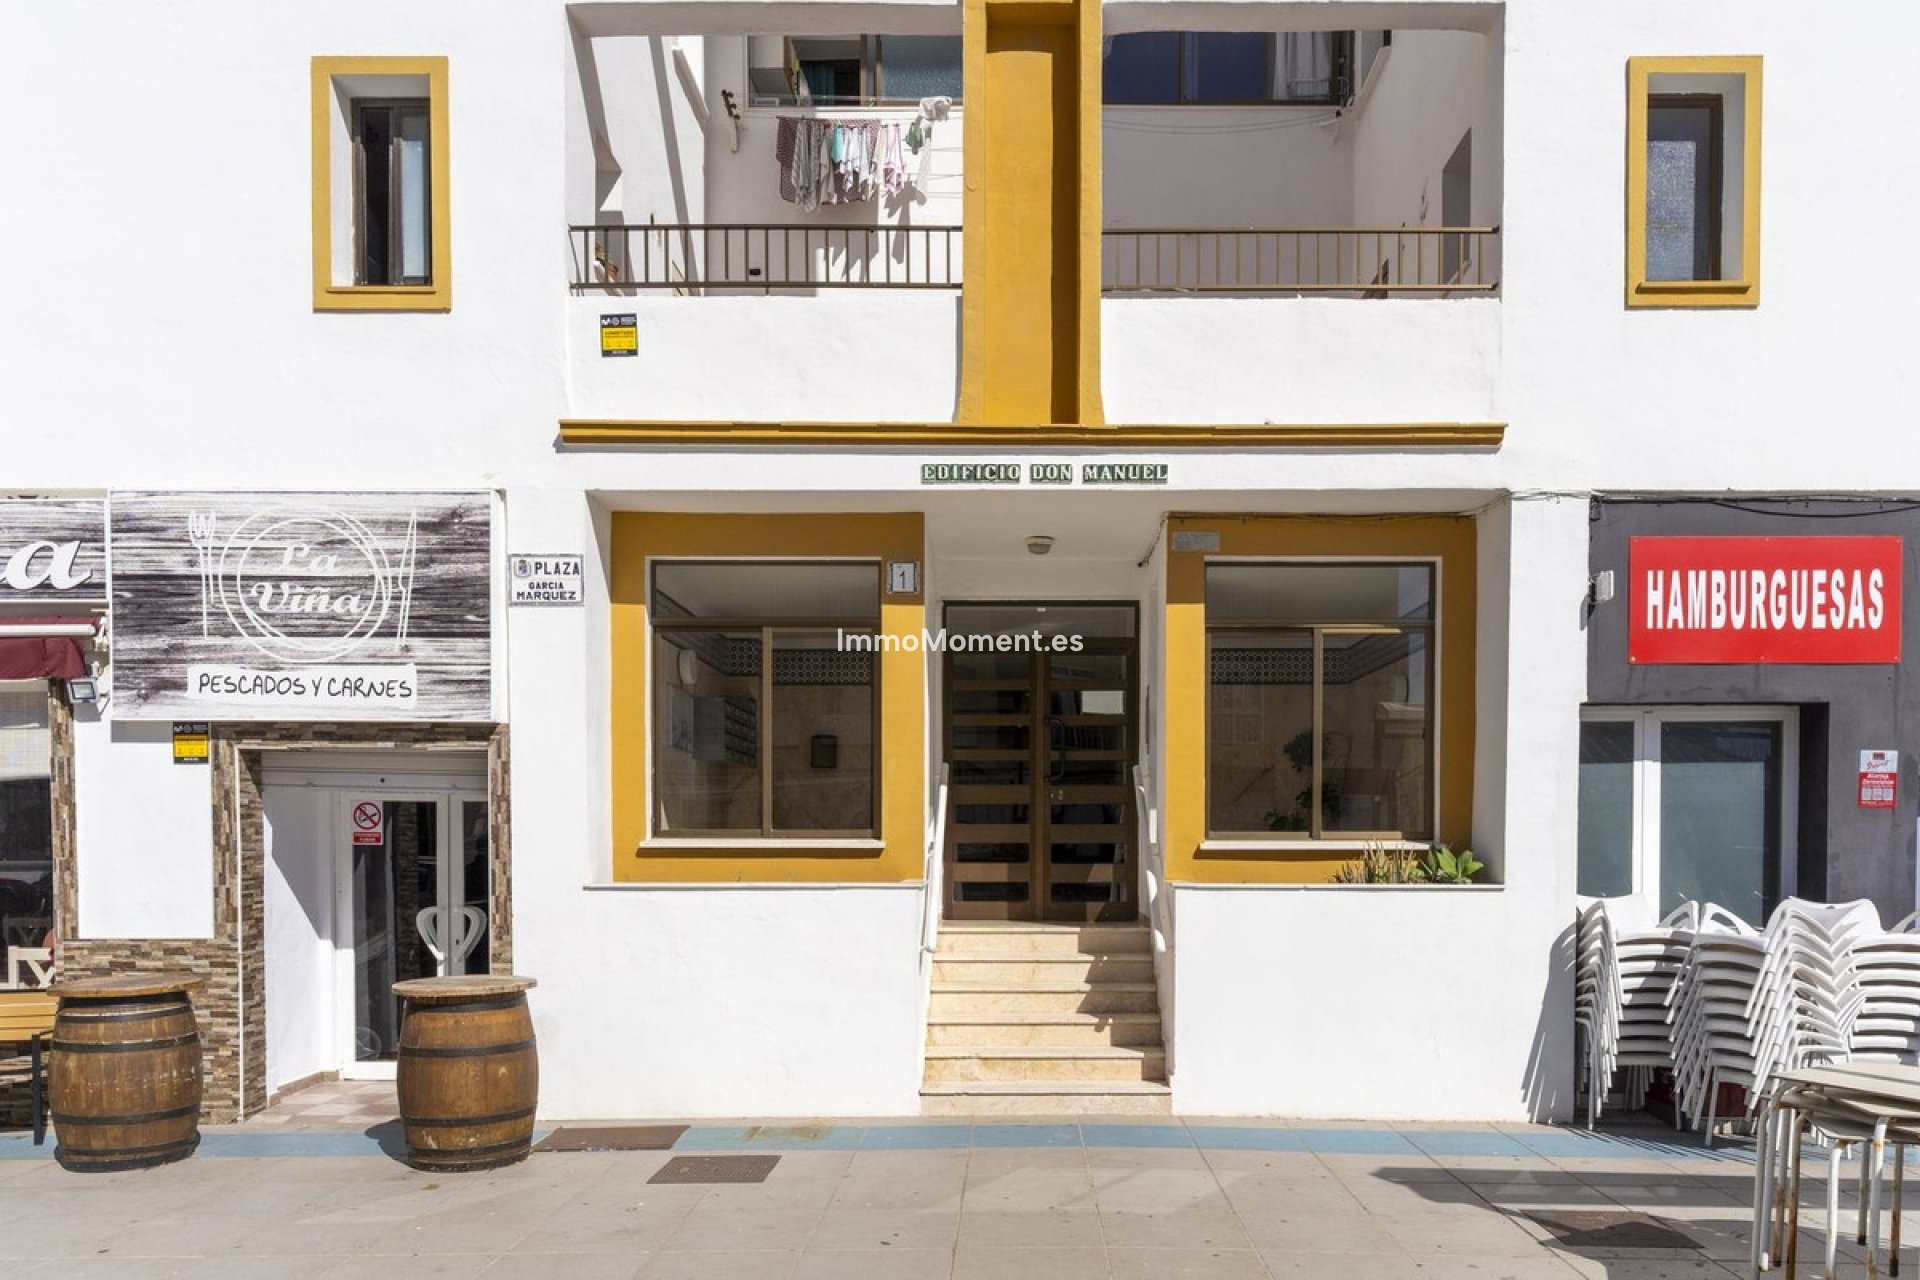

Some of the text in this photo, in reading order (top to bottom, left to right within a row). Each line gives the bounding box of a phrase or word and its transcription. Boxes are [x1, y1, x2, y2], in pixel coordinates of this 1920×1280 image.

[922, 464, 1168, 481] EDIFICIO DON MANUEL
[0, 540, 94, 590] a
[279, 543, 339, 574] La
[534, 561, 580, 575] PLAZA
[528, 581, 564, 590] GARCIA
[898, 570, 906, 590] 1
[250, 582, 368, 614] Viña
[516, 591, 577, 601] MARQUEZ
[1646, 568, 1884, 630] HAMBURGUESAS
[198, 673, 413, 698] PESCADOS Y CARNES
